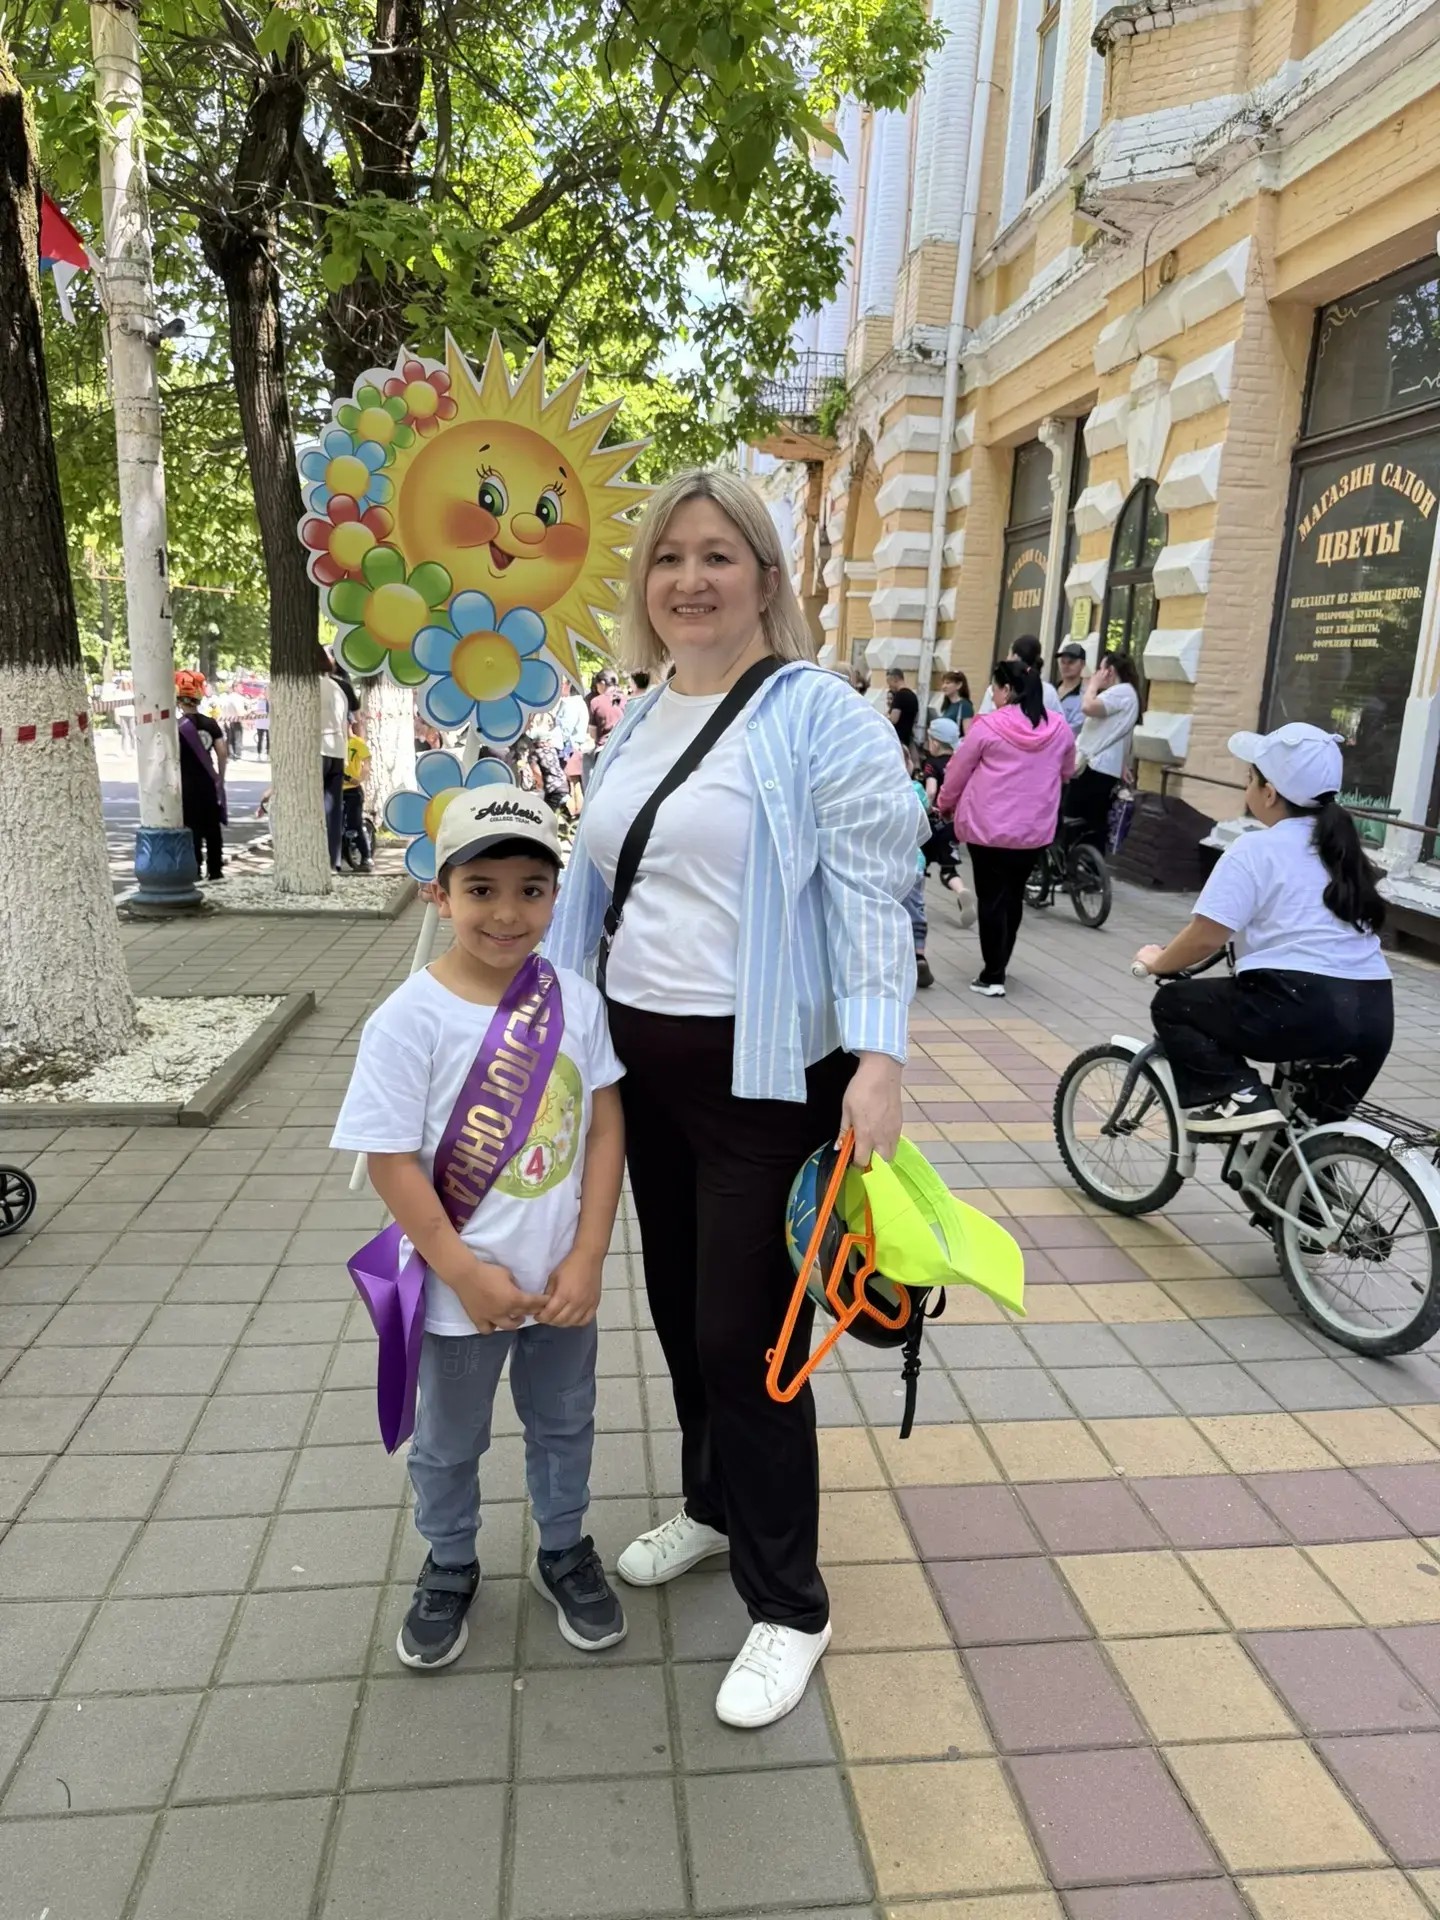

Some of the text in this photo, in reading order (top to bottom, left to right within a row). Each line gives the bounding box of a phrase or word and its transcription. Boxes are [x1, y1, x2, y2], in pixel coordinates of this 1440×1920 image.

[1298, 462, 1437, 542] МАГАЗИН САЛОН
[1316, 520, 1404, 568] ЦВЕТЫ
[1012, 588, 1041, 612] ЦВЕТЫ
[1337, 592, 1349, 604] ИЗ
[474, 801, 543, 825] Athletic
[515, 817, 529, 825] TEAM
[525, 1144, 546, 1183] 4
